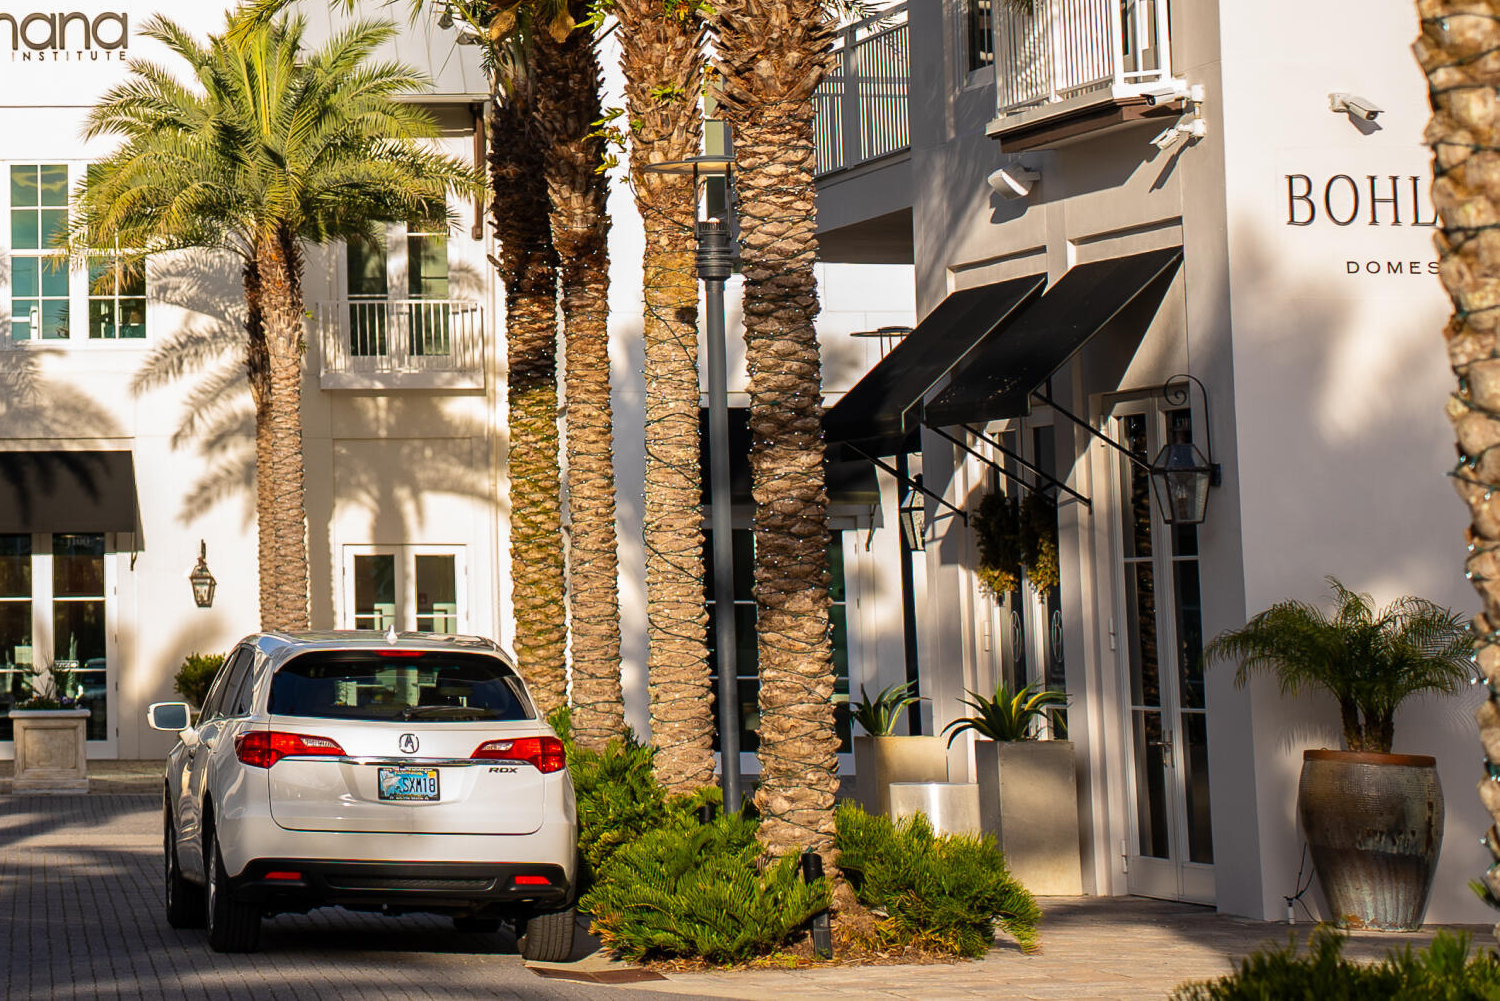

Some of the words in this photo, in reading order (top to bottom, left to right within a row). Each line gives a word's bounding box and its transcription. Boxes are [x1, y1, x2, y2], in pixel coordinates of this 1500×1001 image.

[11, 50, 127, 62] INSTITUTE
[1284, 173, 1440, 227] BOHL
[1346, 260, 1440, 275] DOMES
[488, 766, 519, 774] RDX
